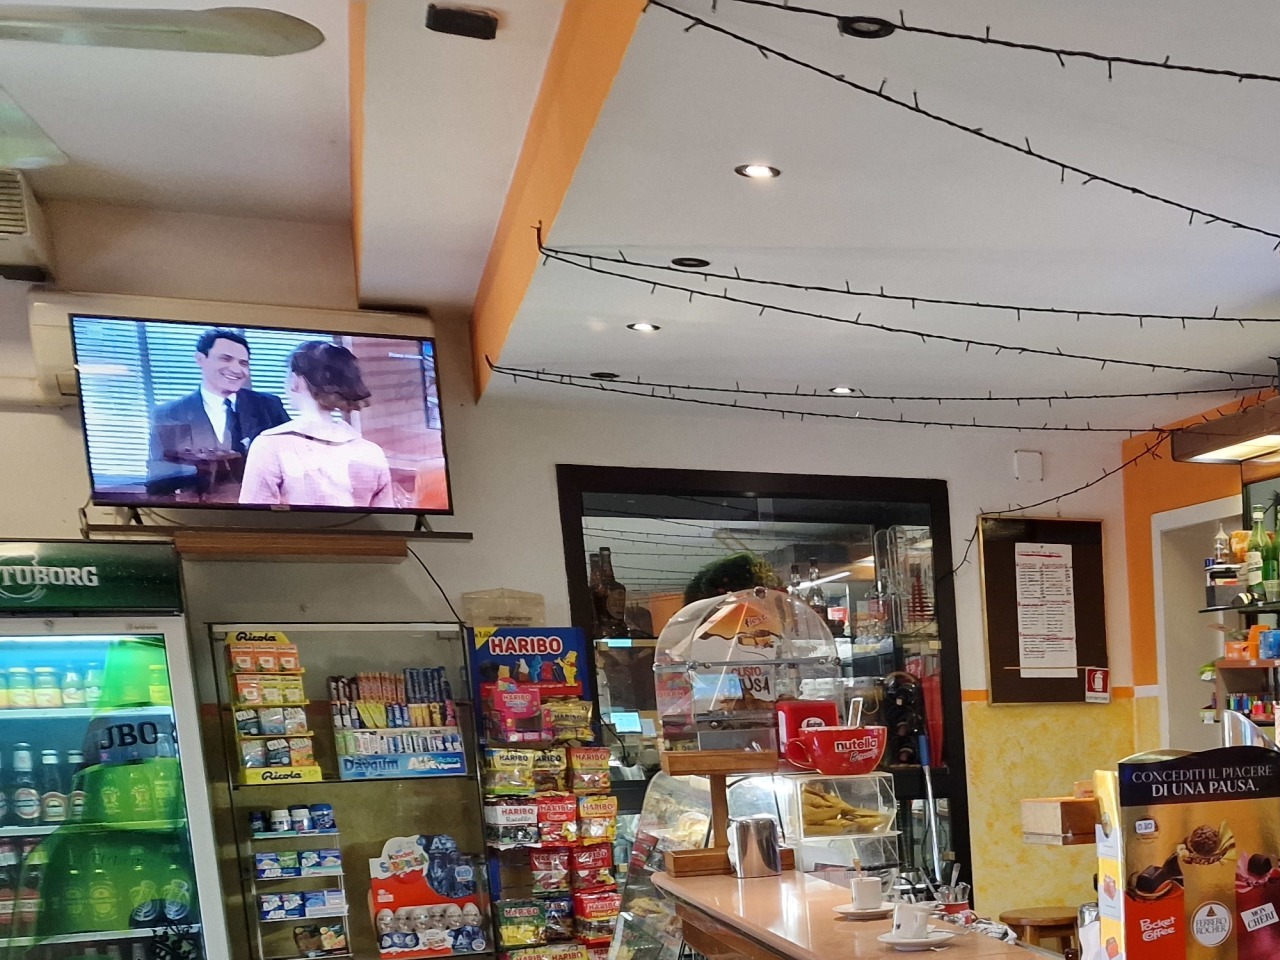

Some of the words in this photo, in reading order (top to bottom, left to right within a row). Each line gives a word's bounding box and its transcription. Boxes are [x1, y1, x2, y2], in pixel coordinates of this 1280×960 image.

[0, 566, 99, 587] TUBORG
[236, 631, 276, 642] Ricola
[490, 636, 562, 654] HARIBO
[503, 693, 531, 701] HARIBO
[554, 713, 582, 721] HARIBO
[835, 736, 877, 752] nutella
[499, 754, 529, 762] HARIBO
[535, 754, 562, 762] ARIBO
[575, 752, 606, 760] HARIBO
[262, 771, 302, 780] Ricola
[1132, 769, 1206, 783] CONCEDITI
[1208, 768, 1220, 779] IL
[1222, 765, 1273, 778] PIACERE
[1152, 784, 1168, 797] DI
[1172, 782, 1205, 796] UNA
[1209, 779, 1260, 794] PAUSA.
[502, 807, 534, 815] HARIBO
[582, 803, 614, 811] HARIBO
[1250, 908, 1266, 918] MON
[1140, 917, 1176, 931] Pocket
[1196, 918, 1227, 927] FERRERO
[1142, 927, 1176, 942] Coffee
[1196, 925, 1227, 935] ROCHER
